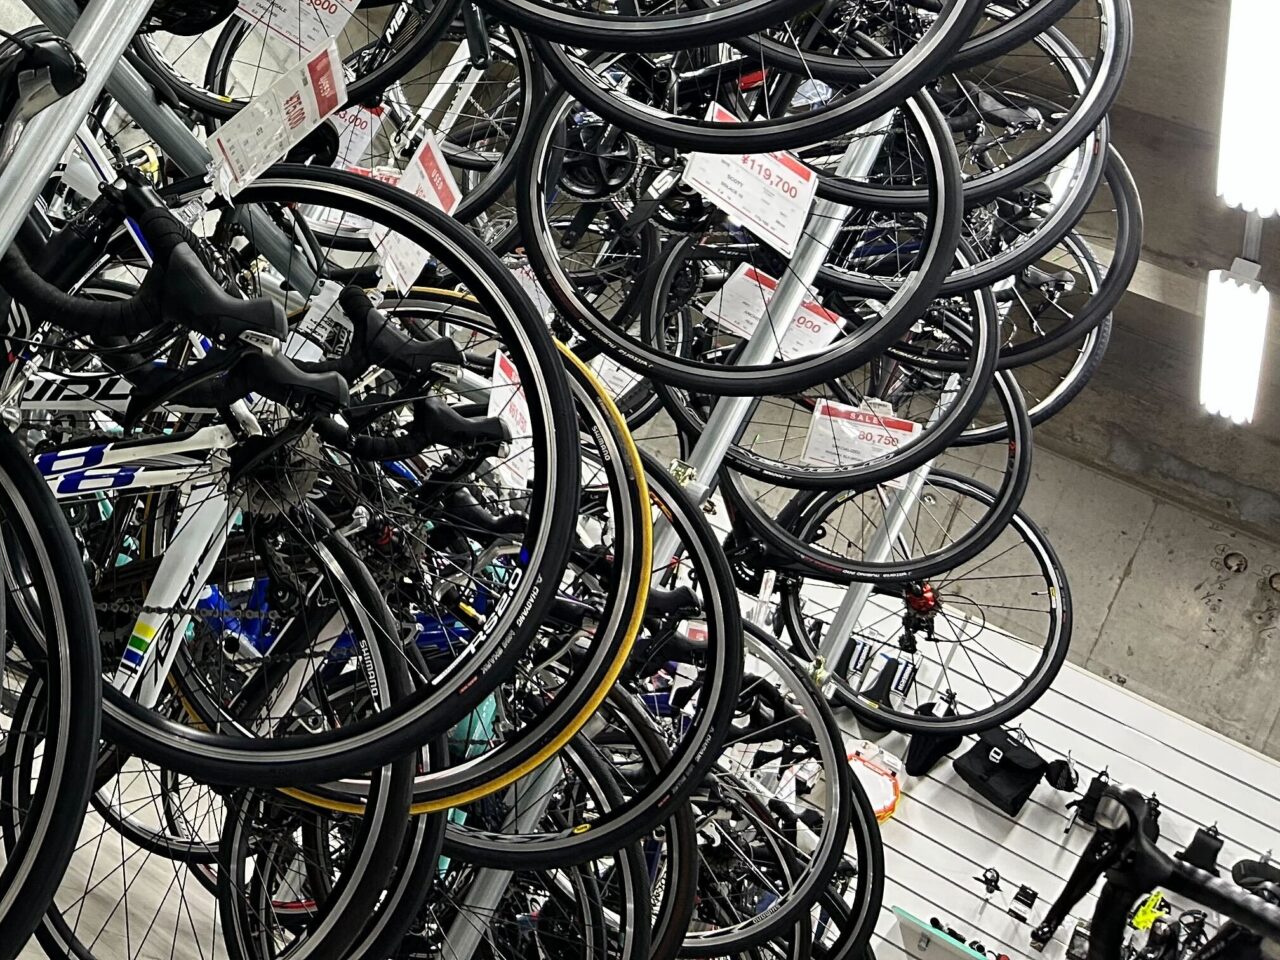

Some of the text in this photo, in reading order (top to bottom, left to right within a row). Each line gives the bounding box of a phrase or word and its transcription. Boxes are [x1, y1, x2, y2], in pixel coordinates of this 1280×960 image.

[431, 168, 443, 191] USED
[726, 174, 744, 187] SCOTT
[737, 153, 802, 200] ¥119,700
[591, 425, 611, 462] SHIMANO
[467, 567, 523, 654] RS2.0
[512, 585, 544, 627] CHAOYANG
[359, 639, 380, 698] SHIMANO
